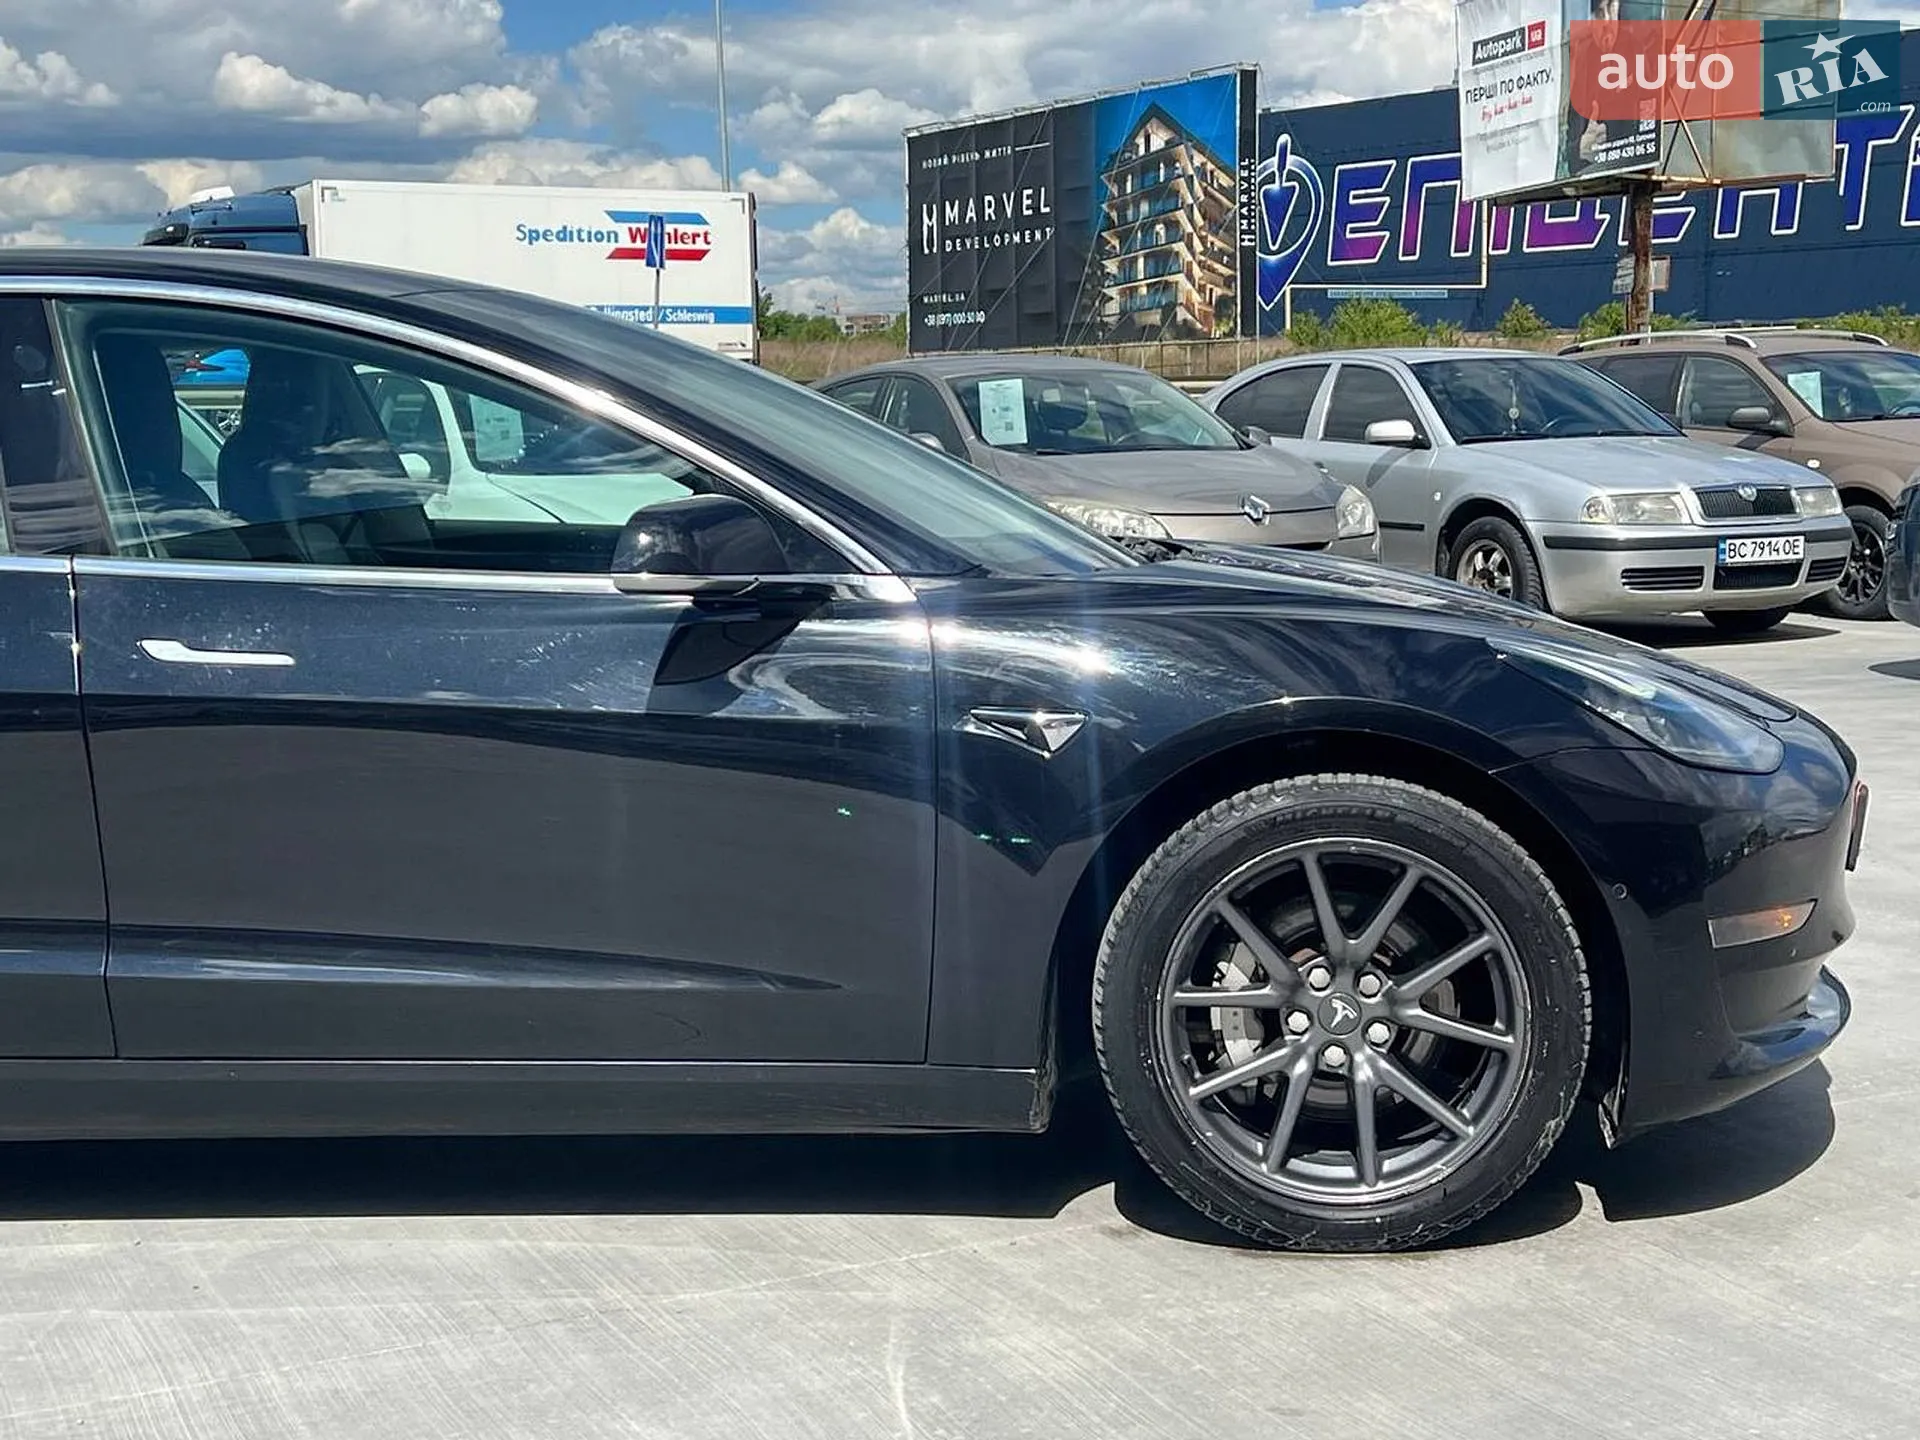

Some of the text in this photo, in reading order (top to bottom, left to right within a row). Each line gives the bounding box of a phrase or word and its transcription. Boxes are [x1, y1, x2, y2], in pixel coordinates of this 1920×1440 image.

[1475, 30, 1522, 60] Autopark
[1500, 78, 1514, 96] ПО
[1240, 158, 1249, 230] MARVEL
[945, 186, 1051, 226] MARVEL
[516, 223, 712, 245] Spedition Wlert
[945, 227, 1054, 252] DEVELOPMENT
[665, 308, 716, 324] Schleswig
[1728, 542, 1747, 559] BC
[1750, 540, 1780, 558] 7914
